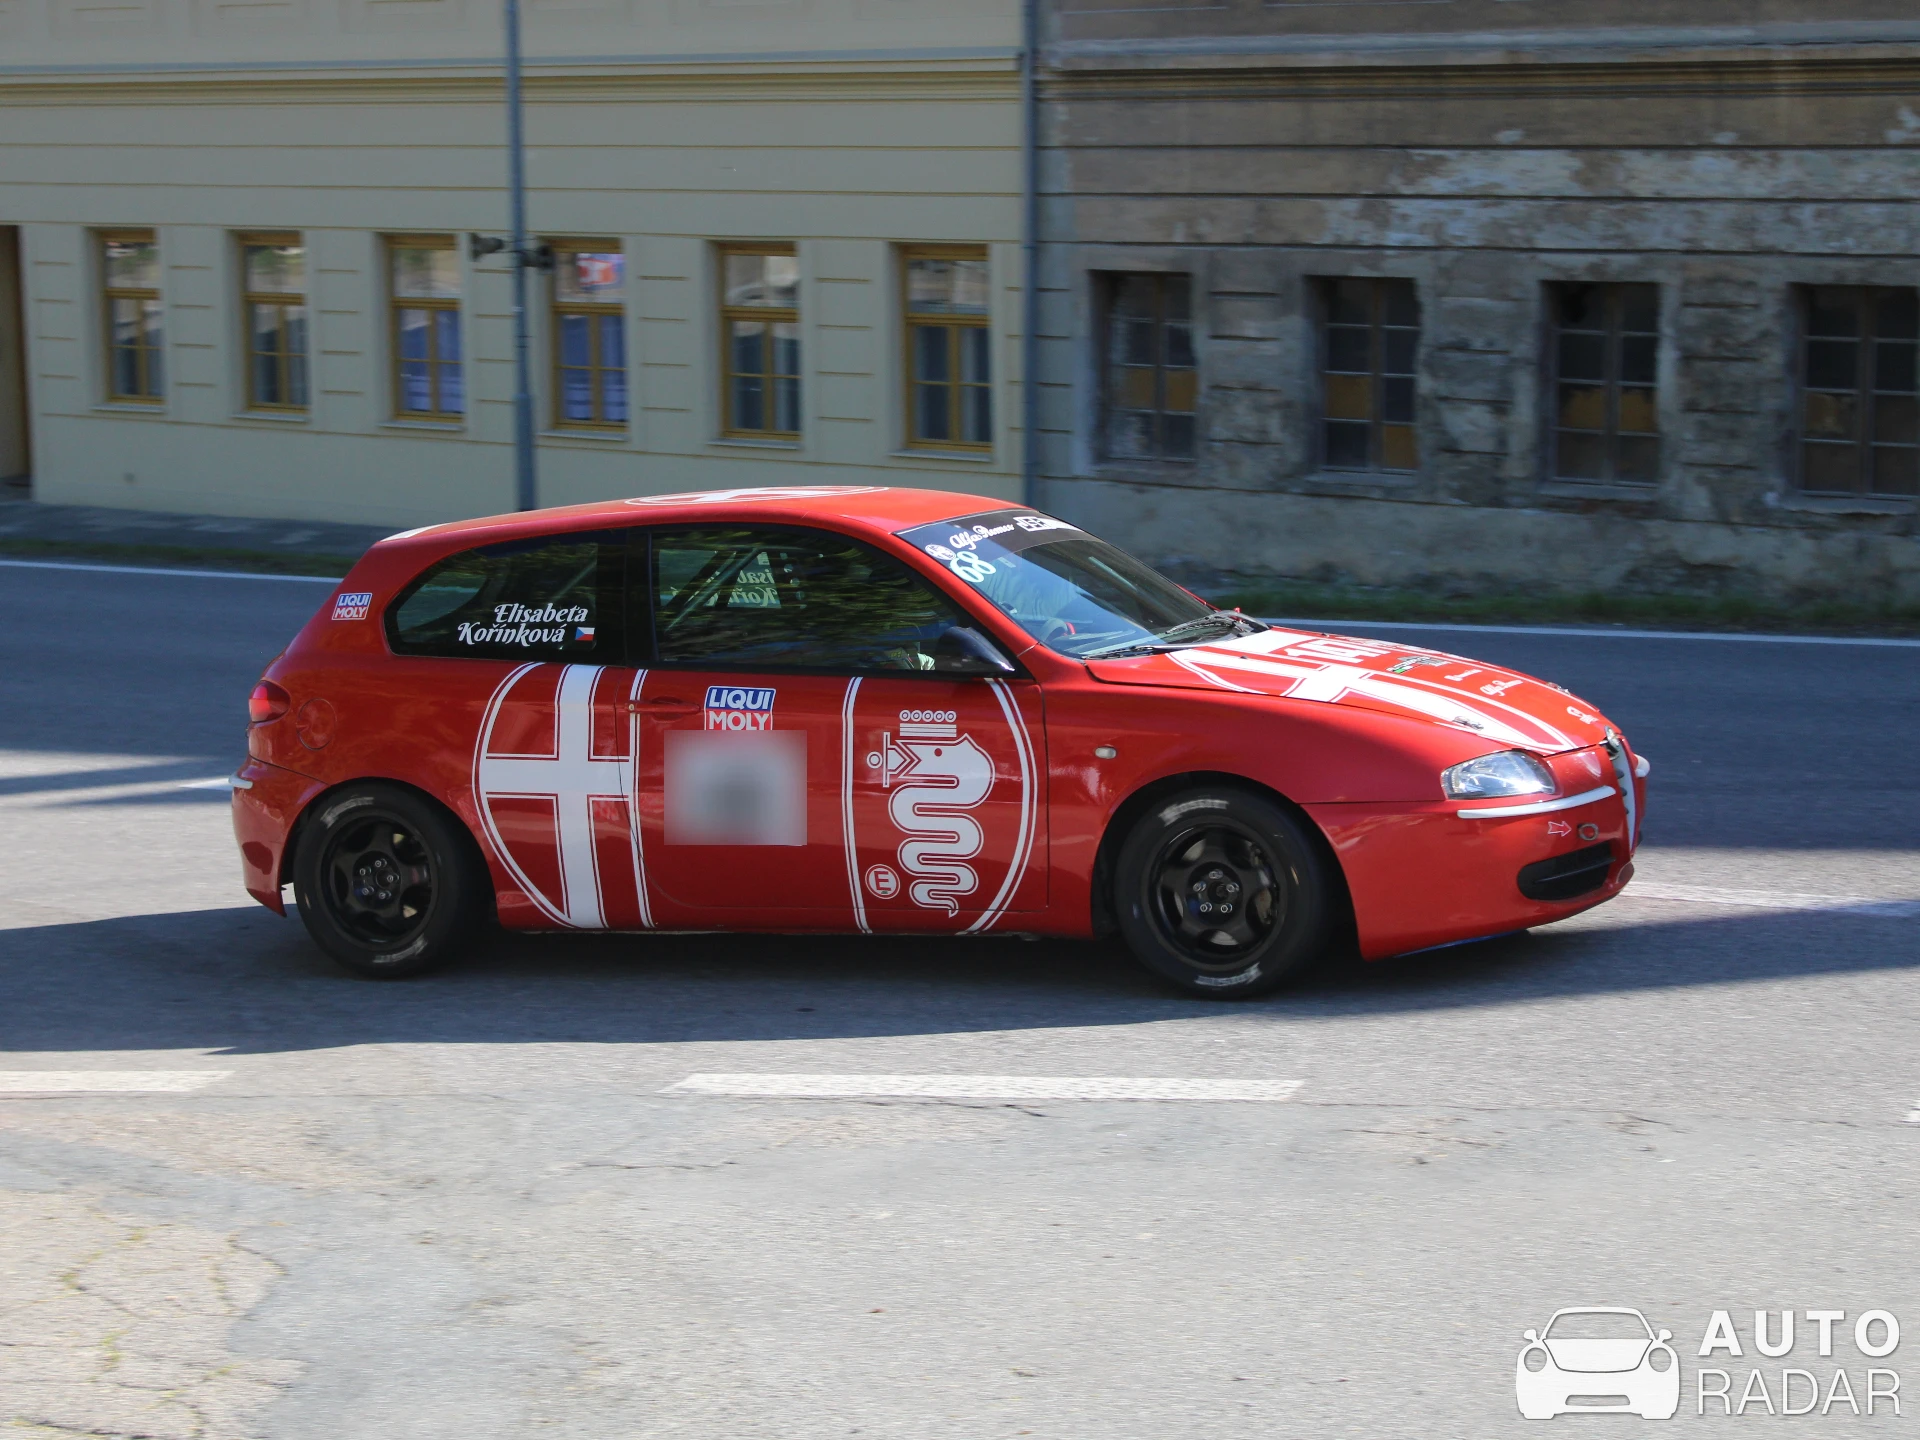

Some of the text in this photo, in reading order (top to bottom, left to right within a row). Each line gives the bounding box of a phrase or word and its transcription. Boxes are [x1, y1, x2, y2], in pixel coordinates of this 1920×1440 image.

[949, 525, 1015, 550] Alfa Romeo
[949, 550, 997, 583] 68
[338, 595, 370, 606] LIQUI
[334, 607, 367, 618] MOLY
[495, 603, 588, 624] Elisabeta
[457, 622, 566, 647] Kořínková
[709, 689, 772, 710] LIQUI
[709, 711, 770, 731] MOLY
[874, 871, 891, 892] E
